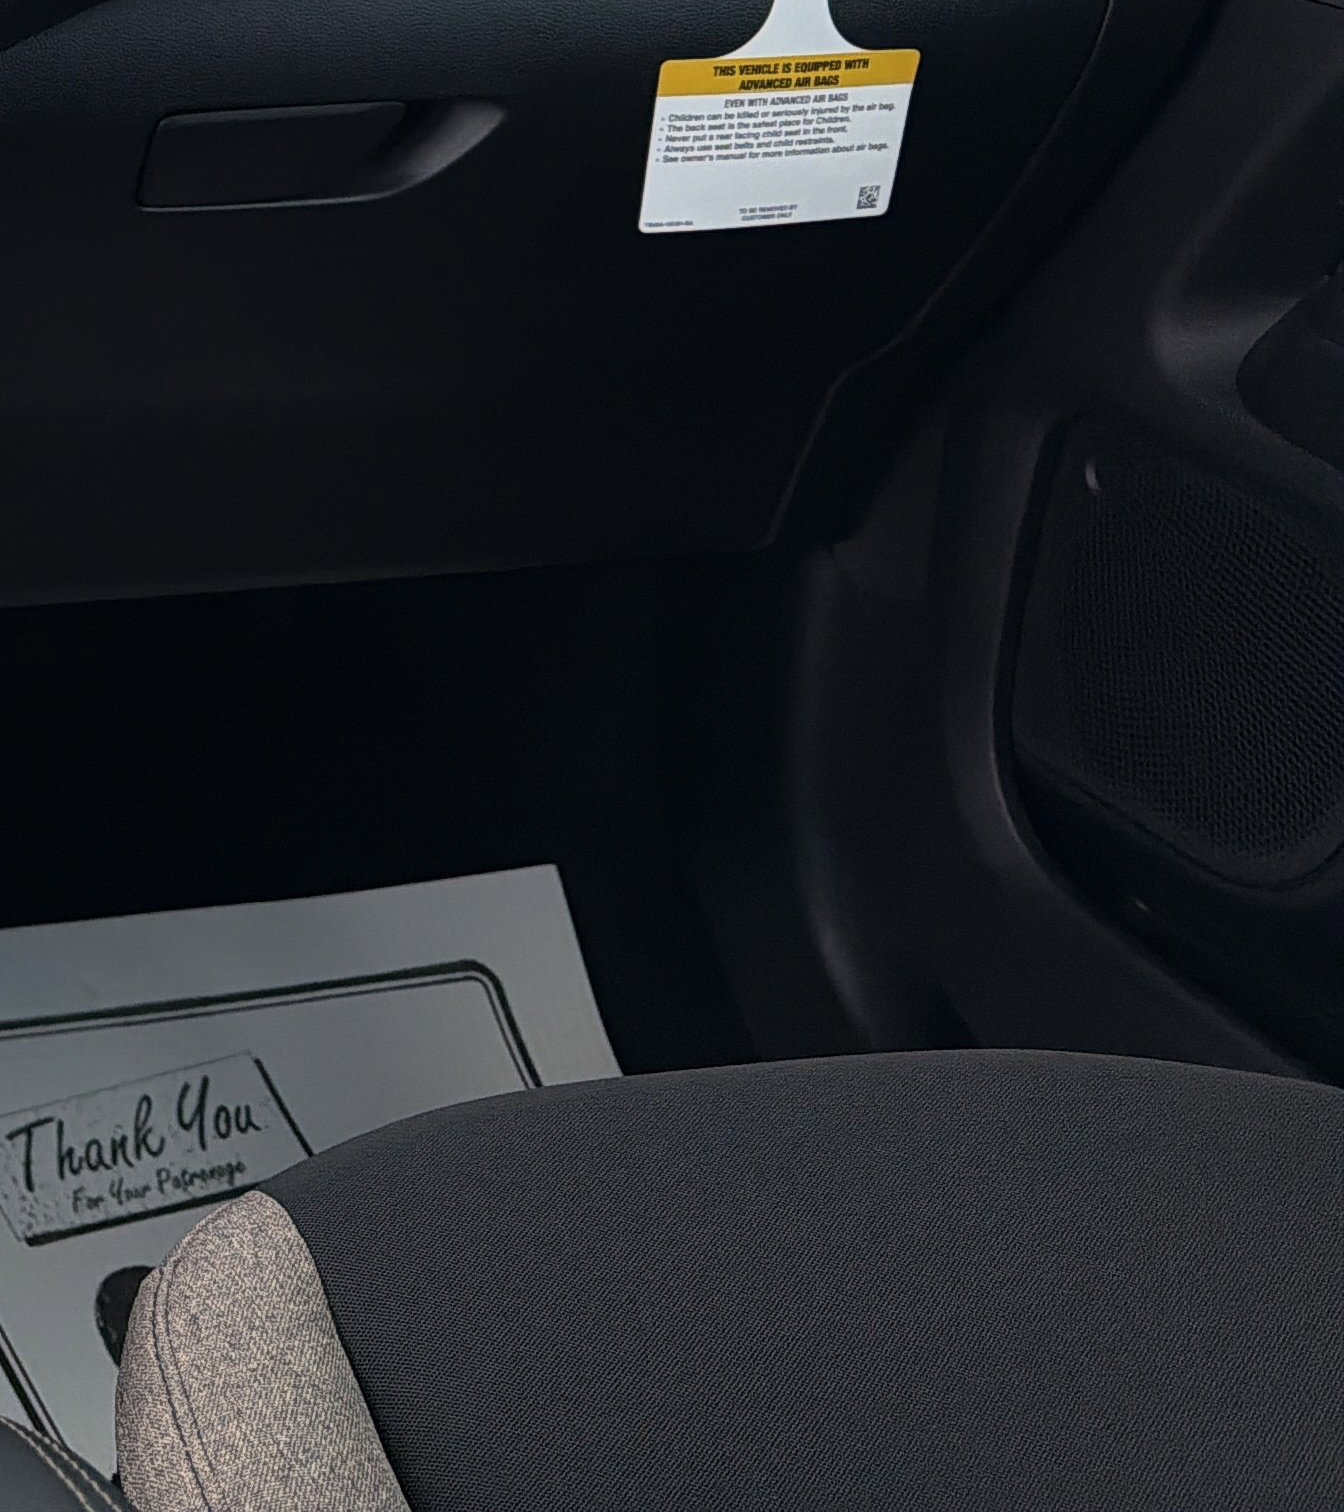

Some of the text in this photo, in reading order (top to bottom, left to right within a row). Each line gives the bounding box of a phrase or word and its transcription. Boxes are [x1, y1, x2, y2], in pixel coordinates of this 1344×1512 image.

[713, 58, 870, 76] THIS VEHICLE IS EQUIPPED WITH
[738, 75, 840, 91] ADVANCED AIR BAGS
[724, 92, 849, 109] EVEN WITH ADVANCED AIR BAGS
[668, 113, 705, 122] Children
[667, 124, 683, 132] The
[665, 134, 691, 143] Never
[664, 145, 695, 154] Always
[662, 155, 679, 163] See
[5, 1074, 262, 1193] Thank You
[72, 1159, 247, 1214] For Your Patronage
